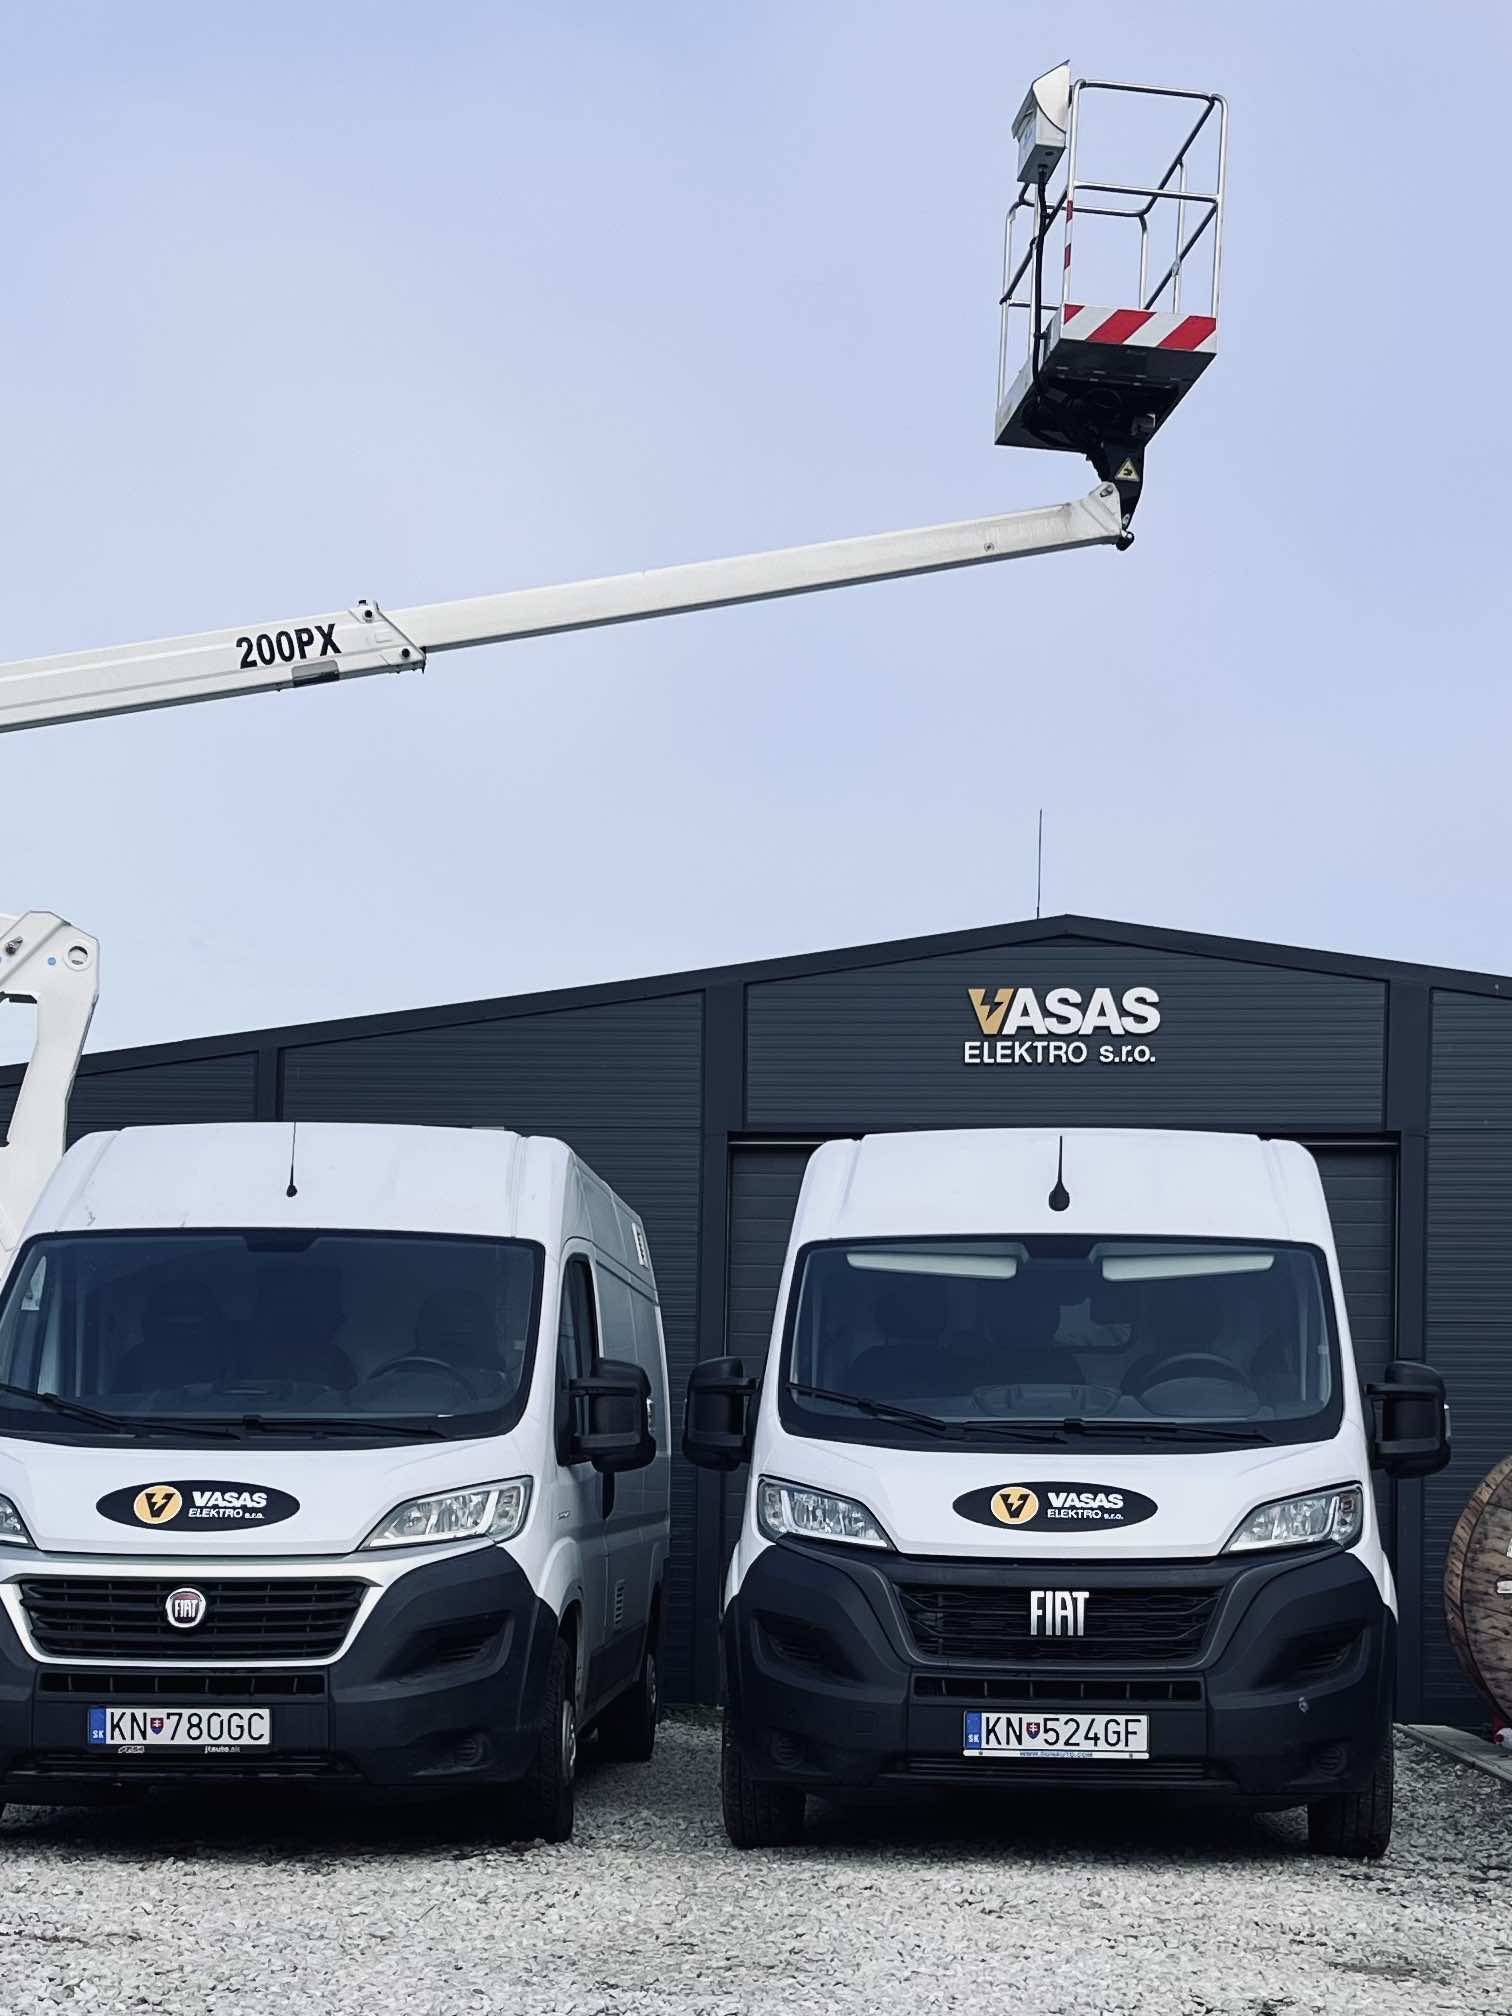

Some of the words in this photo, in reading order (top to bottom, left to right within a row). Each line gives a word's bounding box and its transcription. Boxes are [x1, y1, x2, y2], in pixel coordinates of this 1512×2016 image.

[236, 623, 342, 669] 200PX
[968, 987, 1161, 1035] VASAS
[964, 1041, 1087, 1064] ELEKTRO
[1099, 1045, 1156, 1063] s.r.o.
[191, 1491, 268, 1508] VASAS
[1047, 1492, 1124, 1509] VASAS
[188, 1508, 243, 1518] ELEKTRO
[1047, 1509, 1102, 1519] ELEKTRO
[174, 1599, 198, 1618] FIAT
[1030, 1590, 1090, 1636] FIAT
[92, 1729, 104, 1739] SK
[967, 1733, 980, 1743] SK
